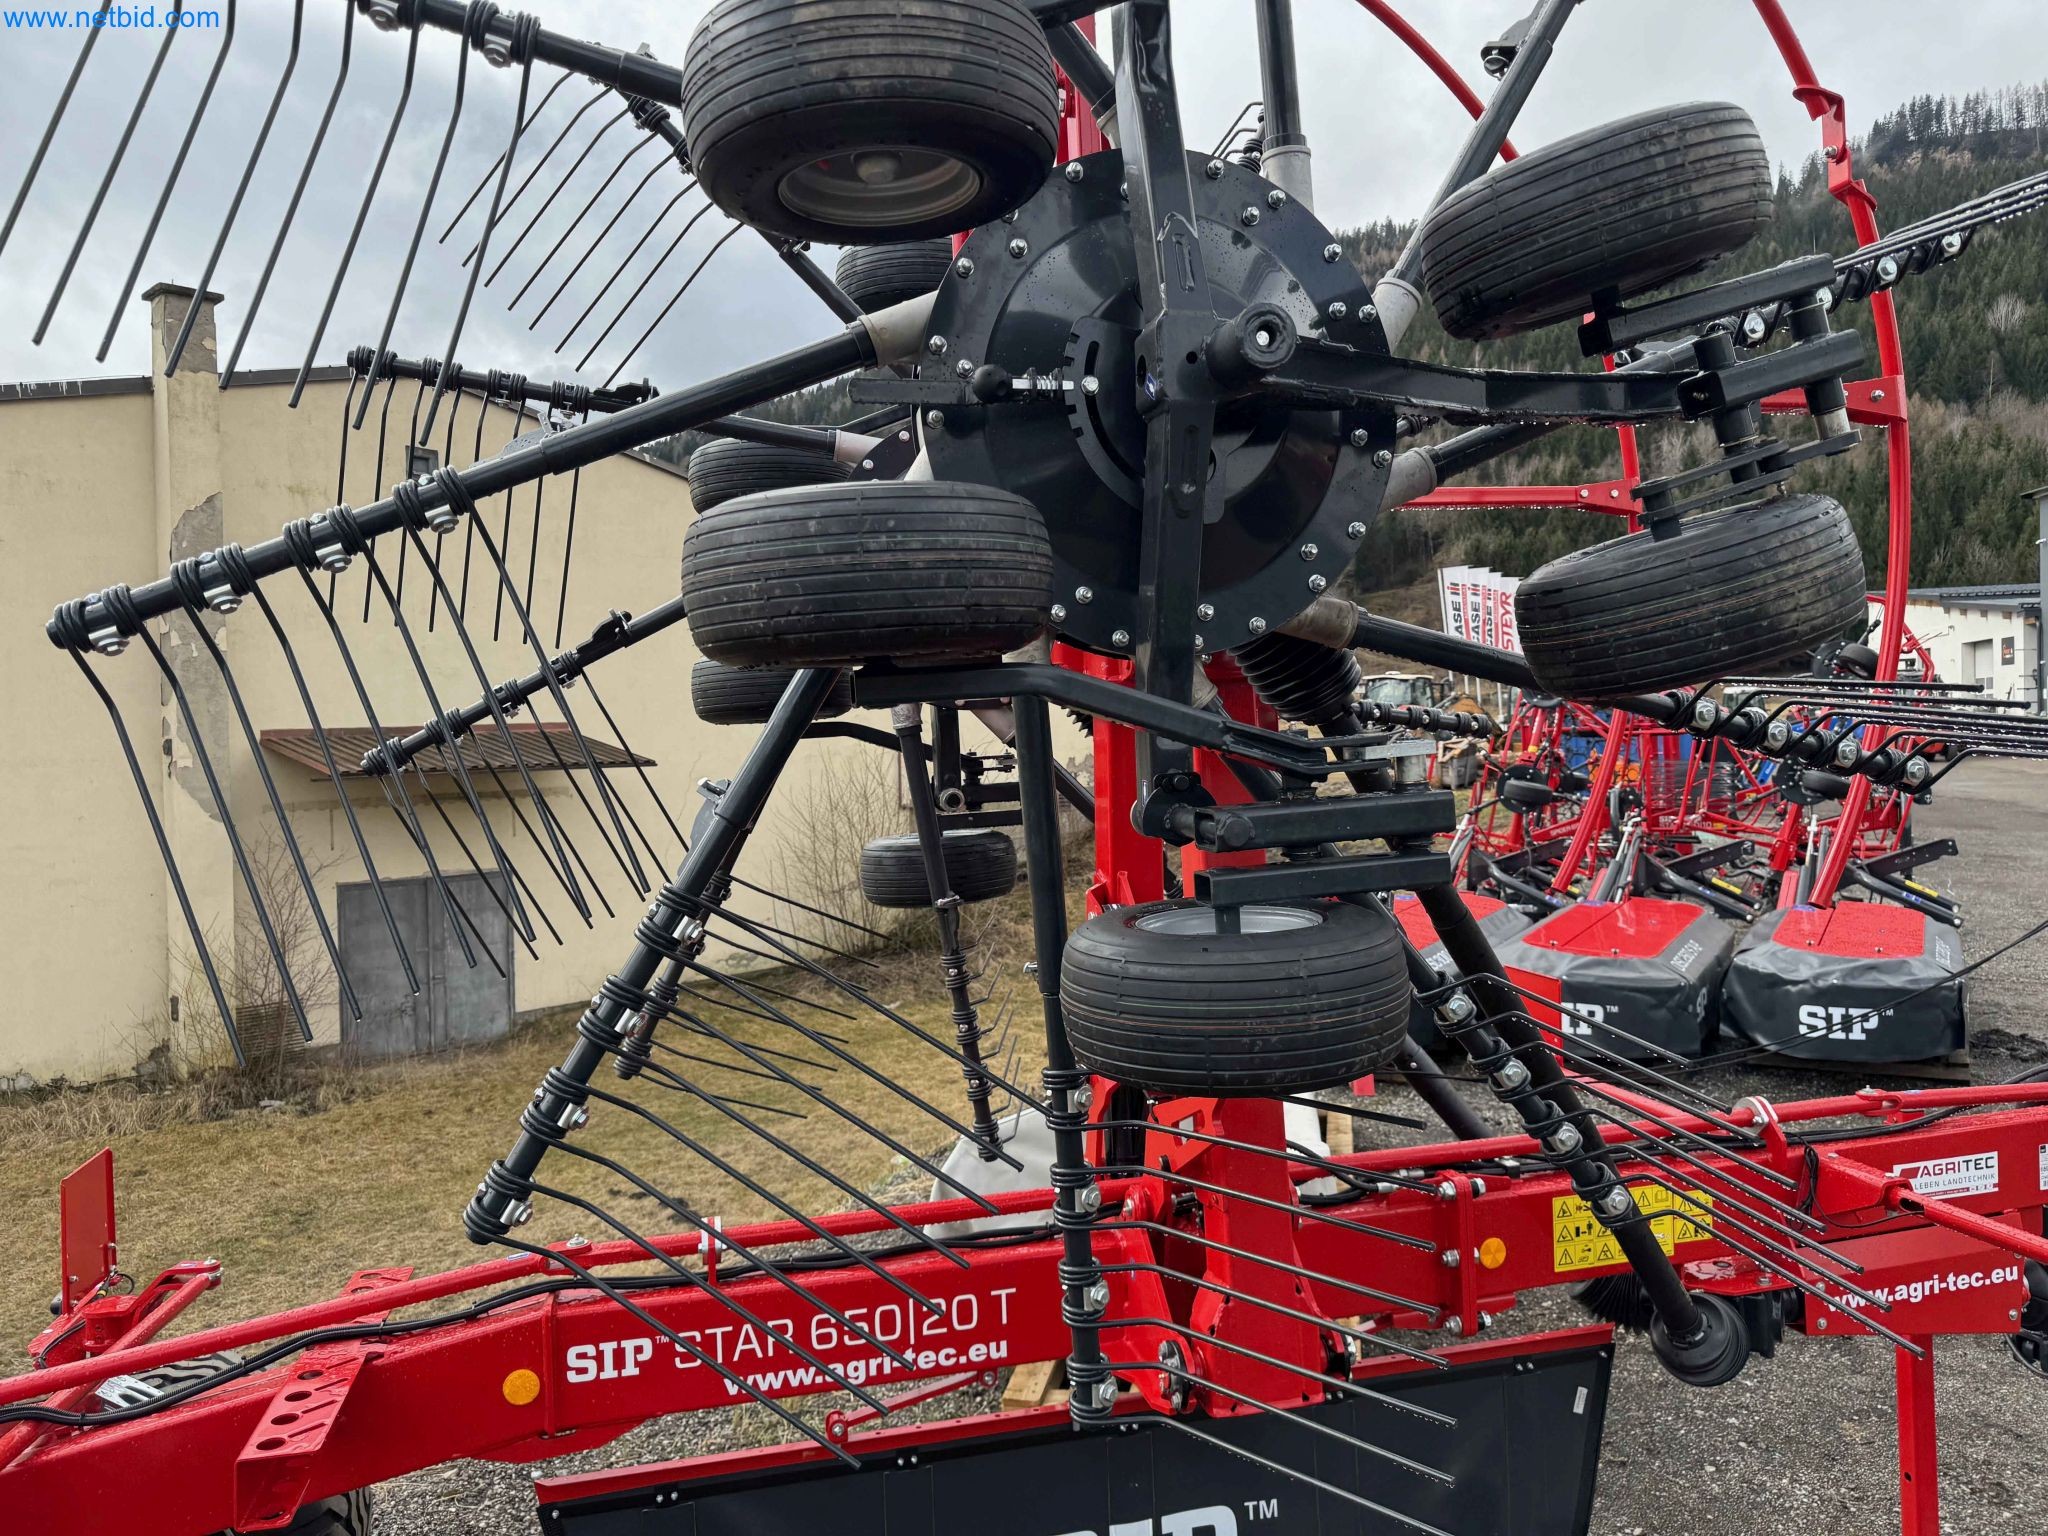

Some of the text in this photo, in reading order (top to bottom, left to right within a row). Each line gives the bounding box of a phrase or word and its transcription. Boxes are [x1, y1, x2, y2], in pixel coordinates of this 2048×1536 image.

[1451, 600, 1464, 637] ASE
[1500, 591, 1515, 652] STEYR
[1561, 1002, 1604, 1035] IP
[1799, 1004, 1879, 1040] SIP
[1914, 1172, 1996, 1191] LEBEN LANDTECHNIK
[1920, 1156, 1995, 1178] AGRITEC
[1825, 1265, 2018, 1311] www.agri-tec.eu
[567, 1337, 653, 1383] SIP
[674, 1318, 794, 1369] STAR
[991, 1288, 1016, 1324] T
